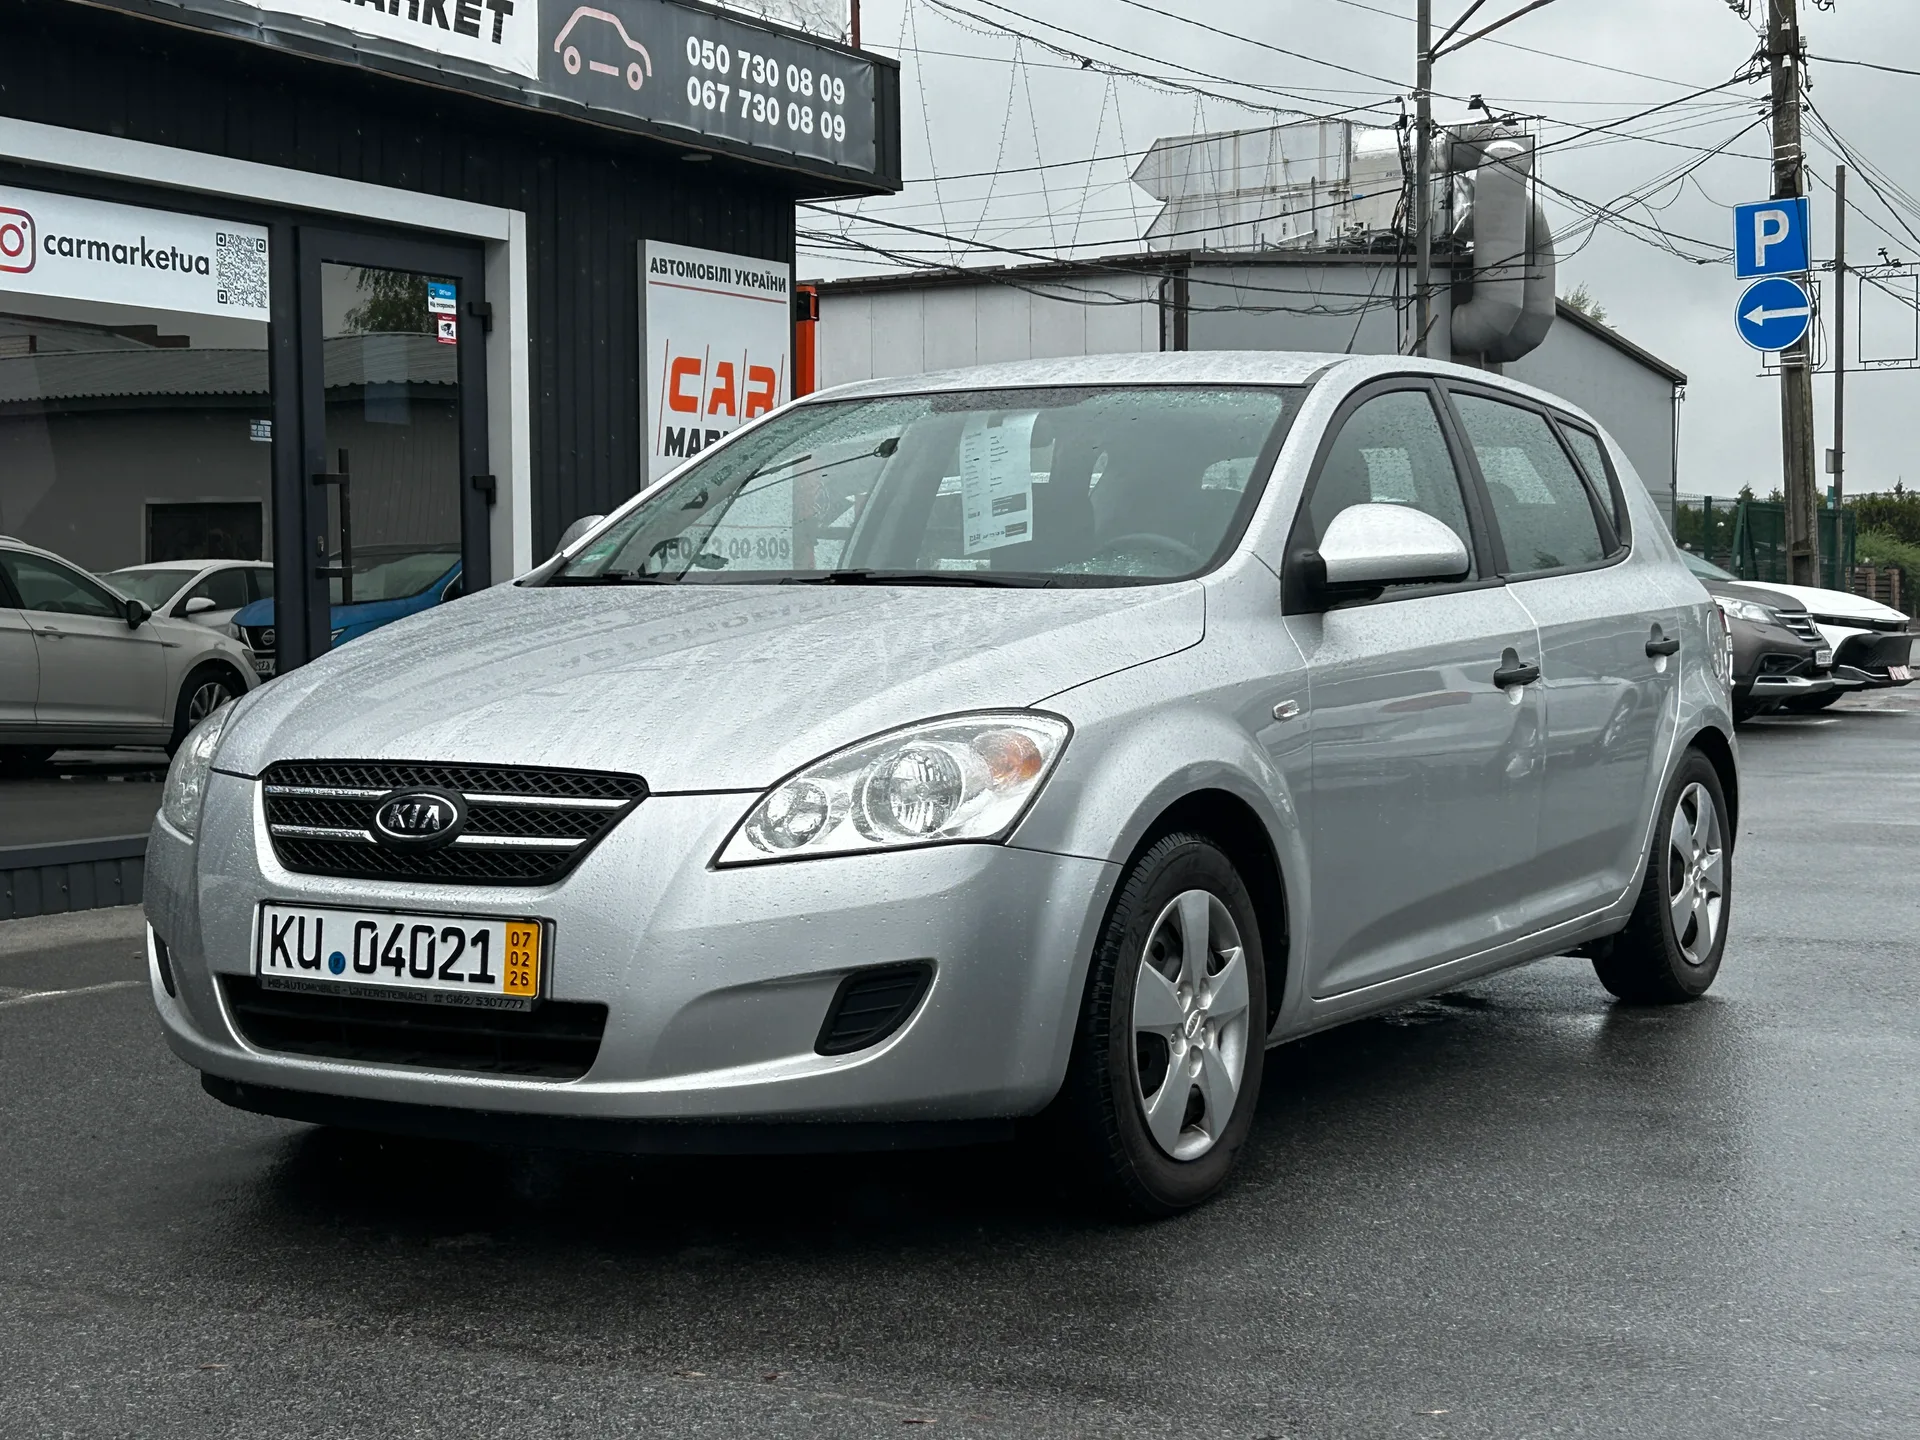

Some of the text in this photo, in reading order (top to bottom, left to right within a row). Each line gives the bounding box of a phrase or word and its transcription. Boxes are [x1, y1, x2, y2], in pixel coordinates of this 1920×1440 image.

[686, 36, 845, 105] 050 730 08 09
[686, 76, 846, 142] 067 730 08 09
[43, 234, 210, 275] carmarketua
[1754, 209, 1789, 267] P
[650, 257, 787, 293] АВТОМОБІЛІ УКРАЇНИ
[669, 356, 776, 418] CAR
[387, 803, 440, 830] KIA
[270, 914, 496, 984] KU 04021
[510, 951, 530, 967] 02
[511, 931, 531, 948] 07
[509, 970, 530, 986] 26
